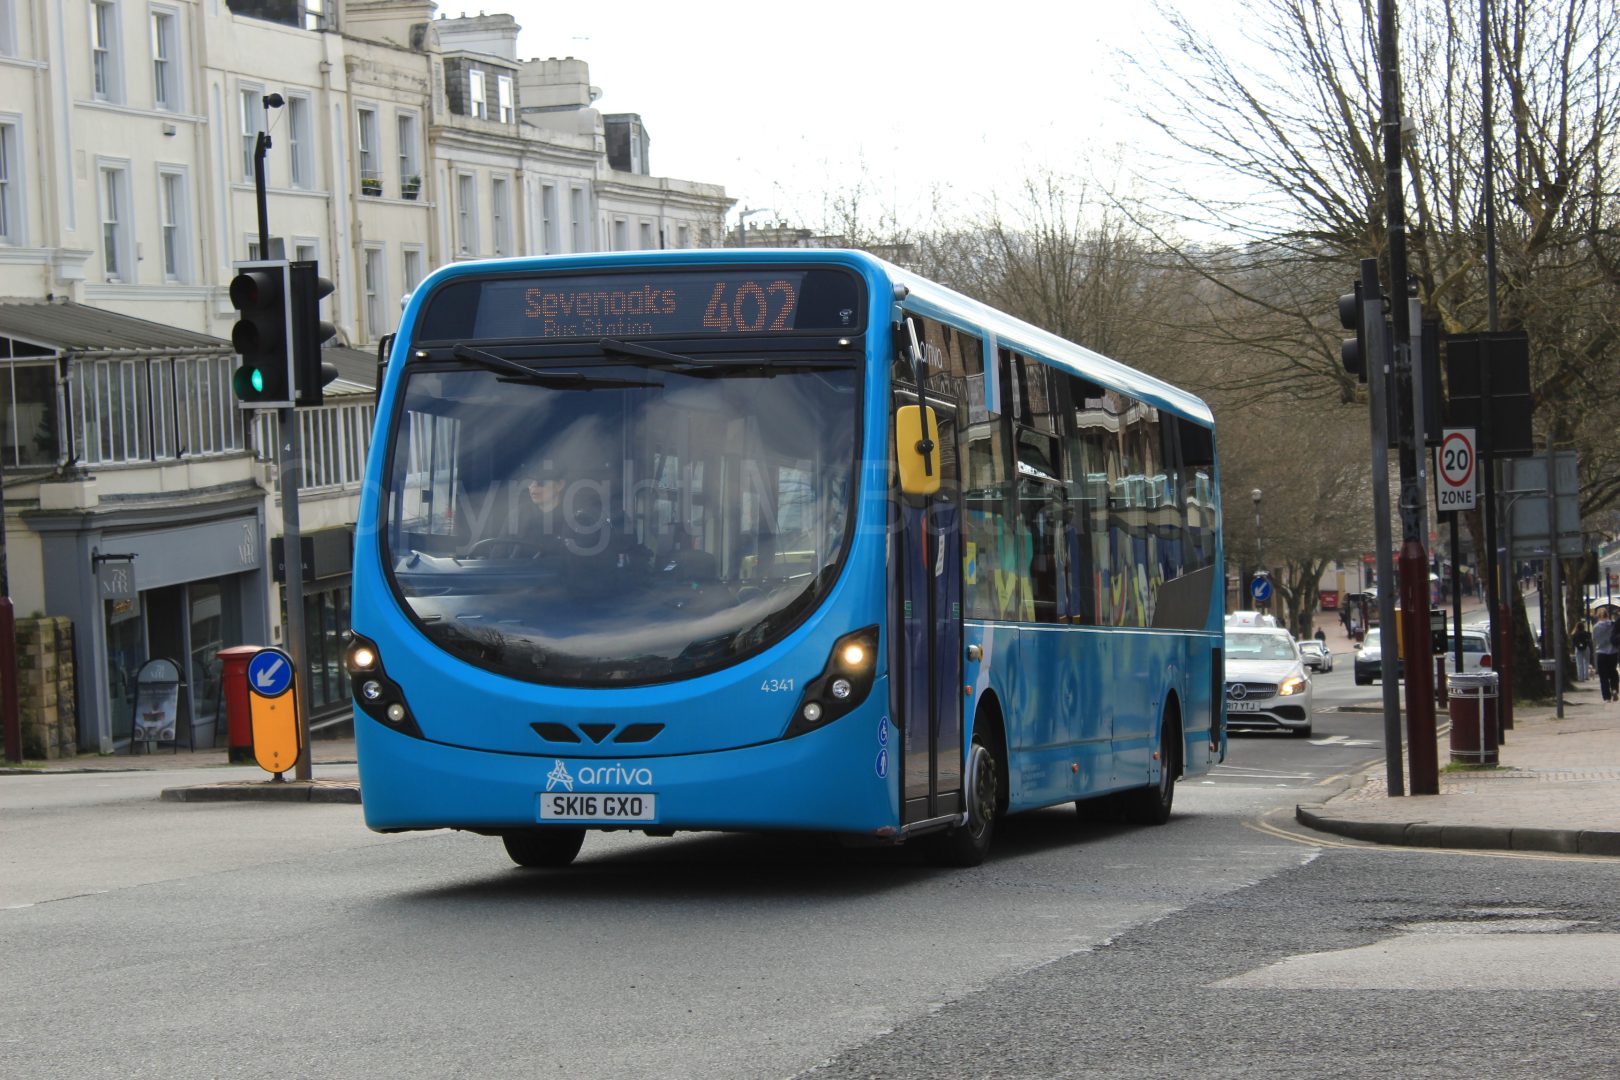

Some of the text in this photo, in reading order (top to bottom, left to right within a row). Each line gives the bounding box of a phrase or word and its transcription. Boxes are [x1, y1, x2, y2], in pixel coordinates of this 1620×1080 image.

[525, 284, 676, 318] Sevenoaks
[703, 281, 795, 332] 402
[543, 317, 652, 336] Bus Station
[1445, 449, 1468, 470] 20
[1441, 491, 1472, 504] ZONE
[112, 569, 127, 581] 78
[761, 679, 794, 692] 4341
[1241, 702, 1255, 710] YTJ
[578, 763, 653, 785] arriva
[553, 796, 643, 816] SK16 GXO
